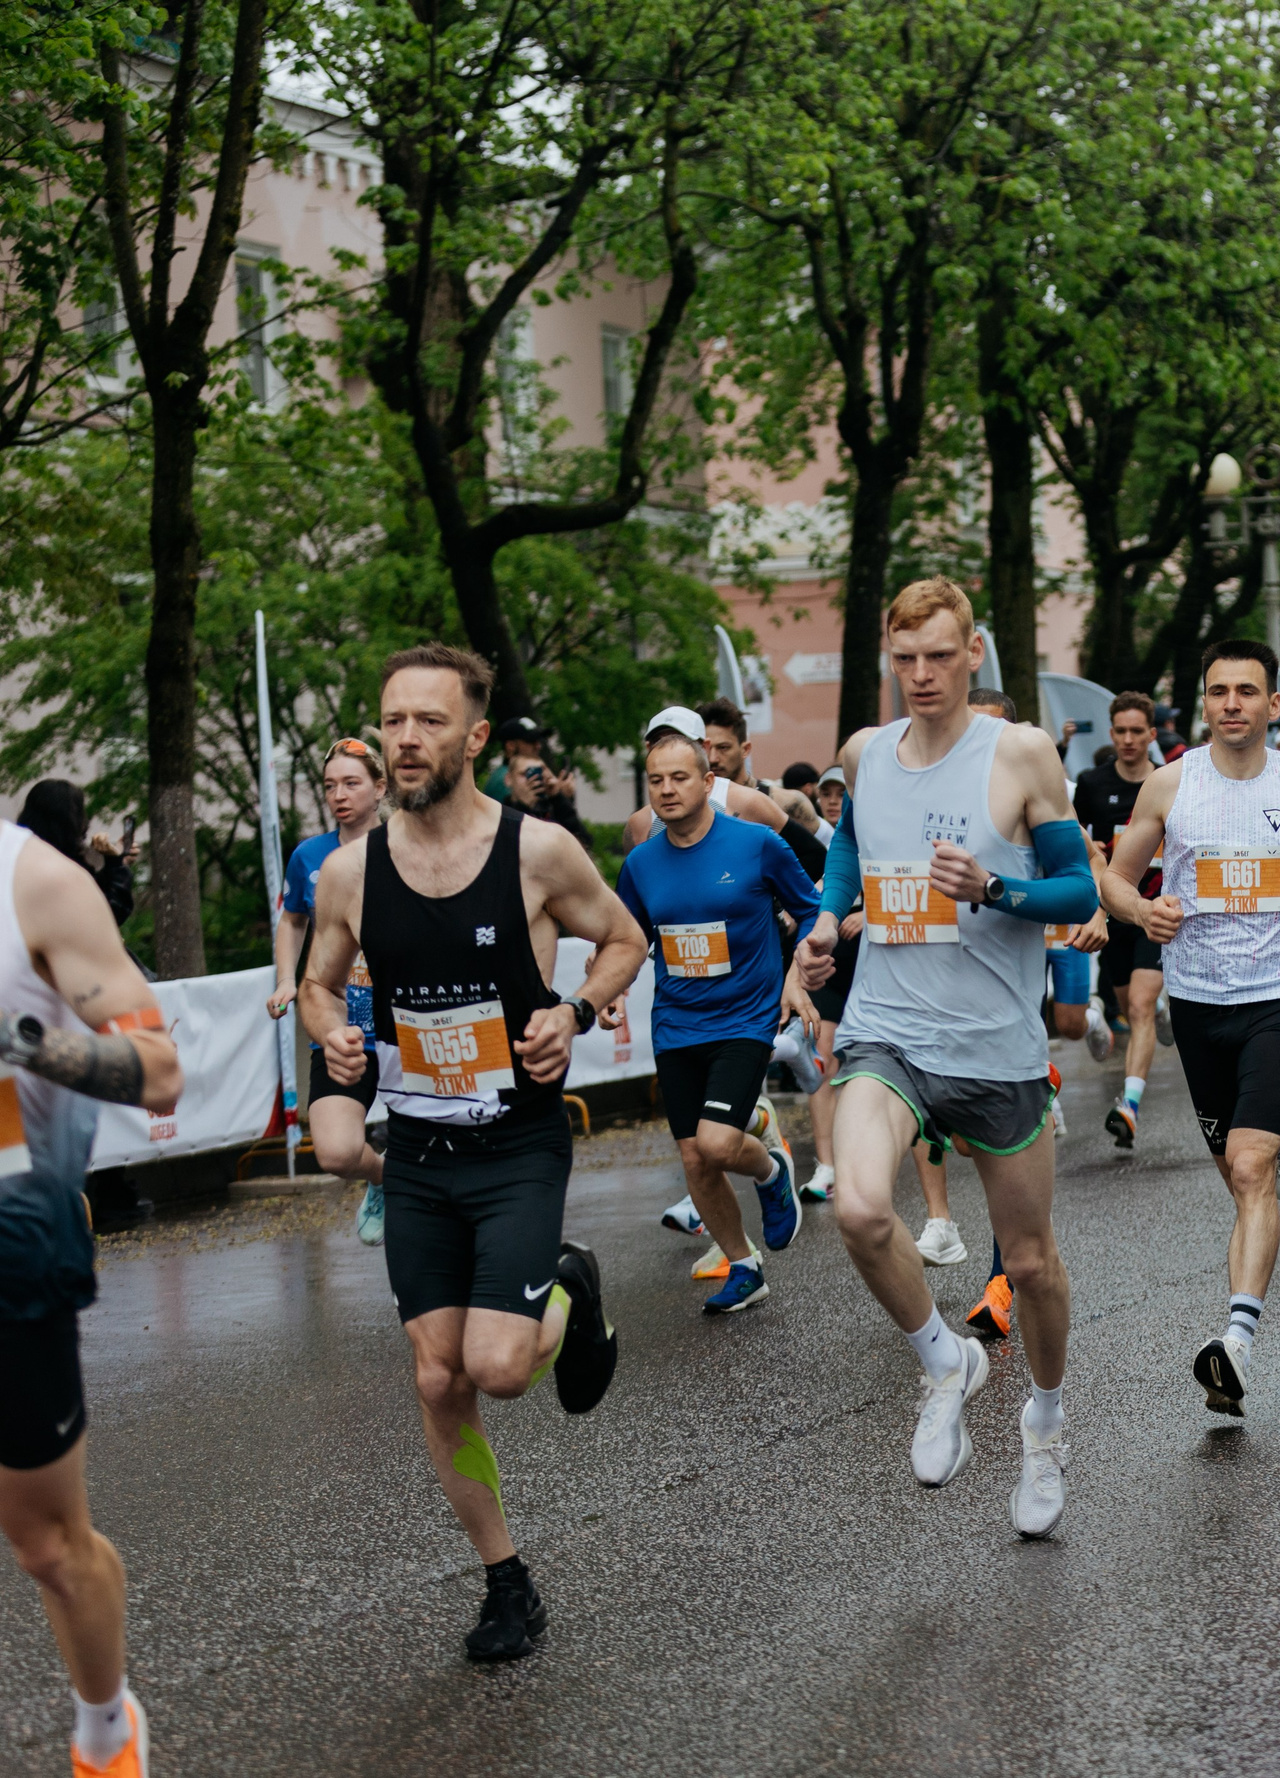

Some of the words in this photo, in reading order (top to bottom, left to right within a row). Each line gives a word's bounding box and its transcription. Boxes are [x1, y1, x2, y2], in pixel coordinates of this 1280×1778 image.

[928, 812, 967, 828] PVLN
[1219, 860, 1261, 889] 1661
[879, 878, 930, 914] 1607
[675, 934, 711, 958] 1708
[396, 982, 498, 996] PIRANHA
[411, 996, 454, 1005] RUNNING
[456, 995, 482, 1003] CLUB
[417, 1025, 479, 1065] 1655
